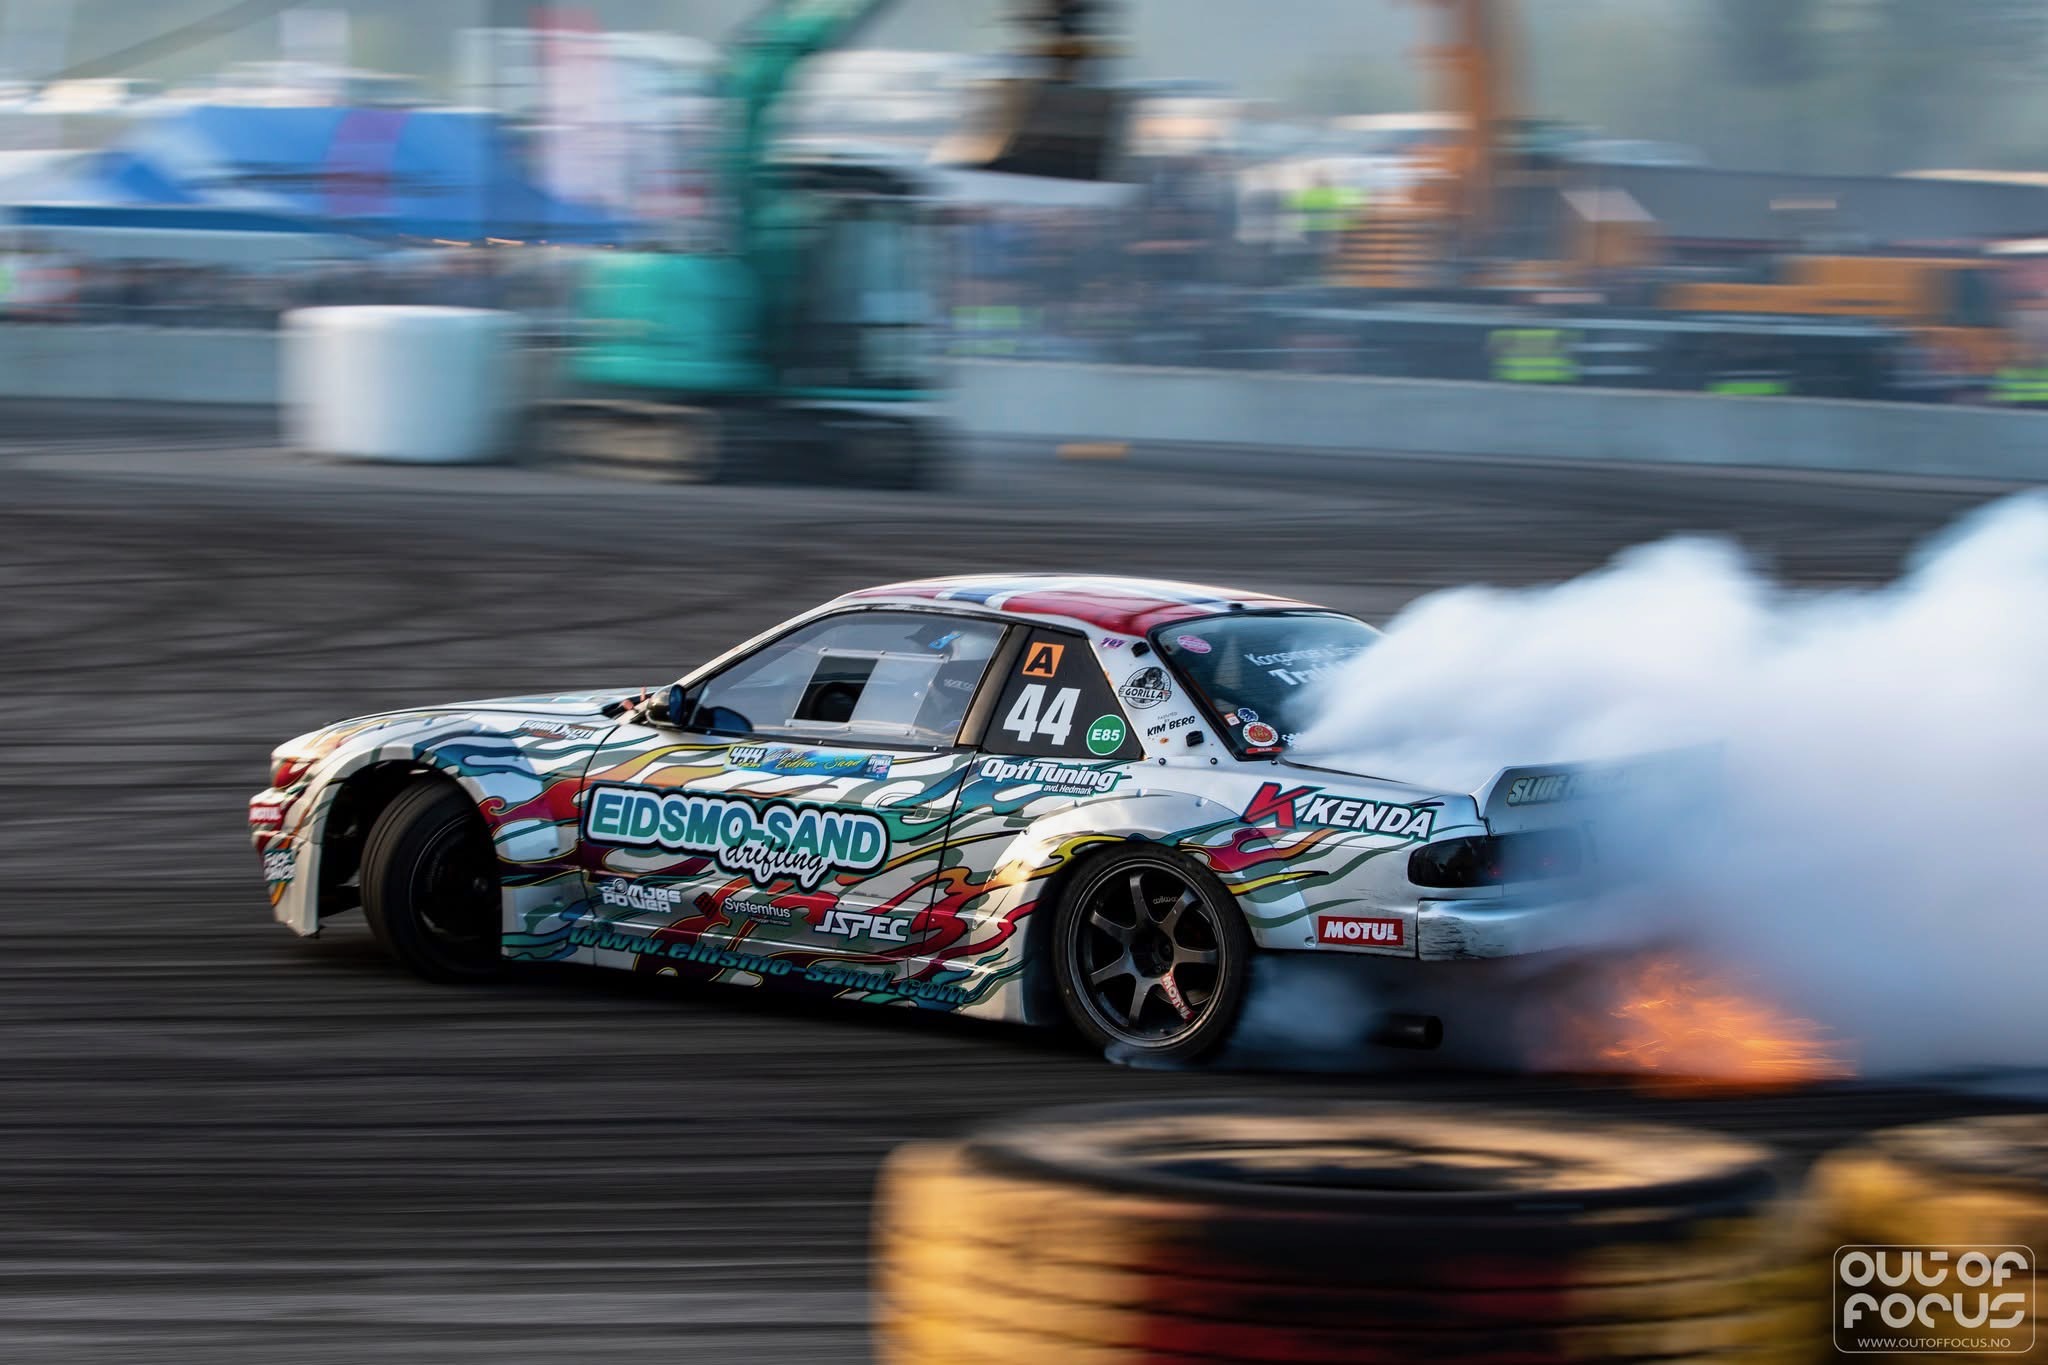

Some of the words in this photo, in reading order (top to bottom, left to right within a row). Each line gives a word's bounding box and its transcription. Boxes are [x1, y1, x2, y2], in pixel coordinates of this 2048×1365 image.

[1027, 646, 1055, 676] A
[1124, 687, 1164, 700] GORILLA
[1003, 684, 1082, 746] 44
[1147, 723, 1166, 737] KIM
[1169, 715, 1196, 730] BERG
[1091, 729, 1121, 742] E85
[730, 746, 767, 764] 444
[980, 758, 1118, 792] OptiTuning
[1043, 784, 1059, 793] avd.
[1060, 785, 1093, 796] Hedmark
[592, 793, 882, 863] EIDSMO-SAND
[1303, 797, 1437, 840] KENDA
[725, 837, 824, 882] drifting
[602, 892, 672, 913] POWER
[724, 897, 791, 918] Systemhus
[815, 910, 910, 942] JSPEC
[1323, 920, 1399, 942] MOTUL
